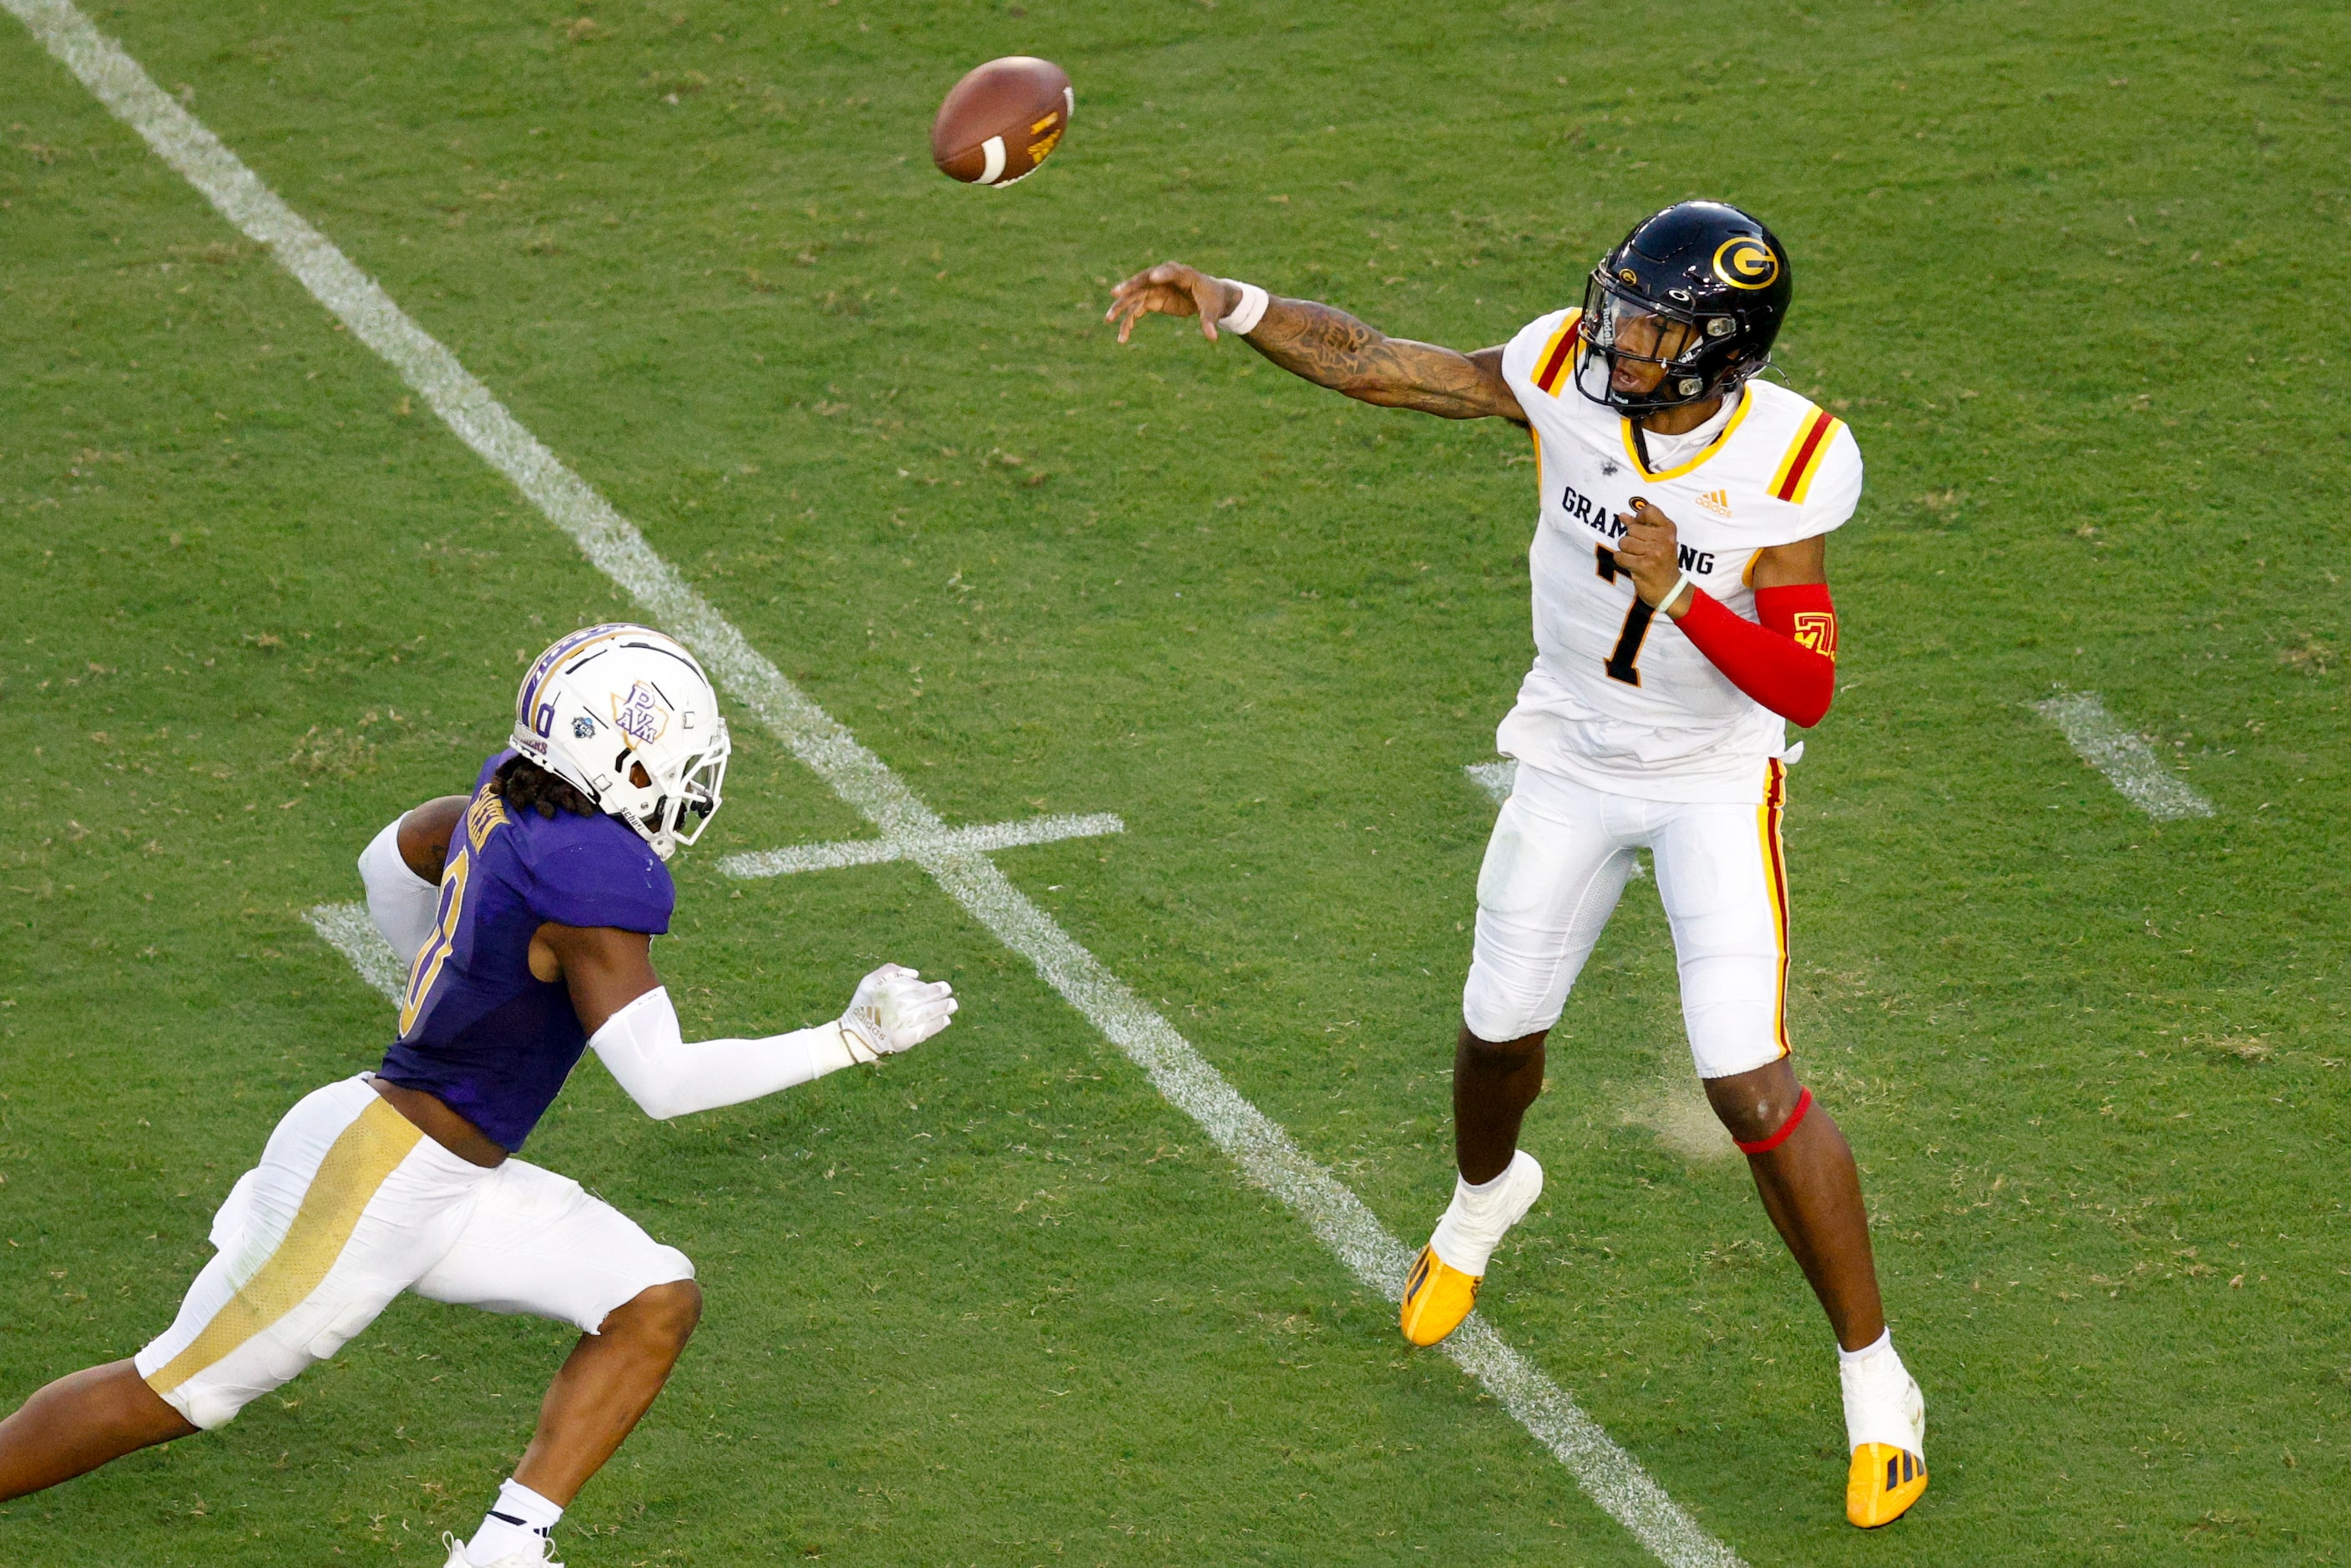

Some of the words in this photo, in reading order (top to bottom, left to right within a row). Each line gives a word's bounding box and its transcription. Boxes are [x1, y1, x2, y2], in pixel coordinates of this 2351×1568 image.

[1712, 236, 1779, 291] G
[1562, 486, 1716, 575] GRAMNG
[1695, 496, 1733, 518] adidas
[1595, 541, 1656, 688] 7
[535, 702, 555, 739] 0
[398, 845, 469, 1039] 0
[853, 1007, 887, 1041] adidas
